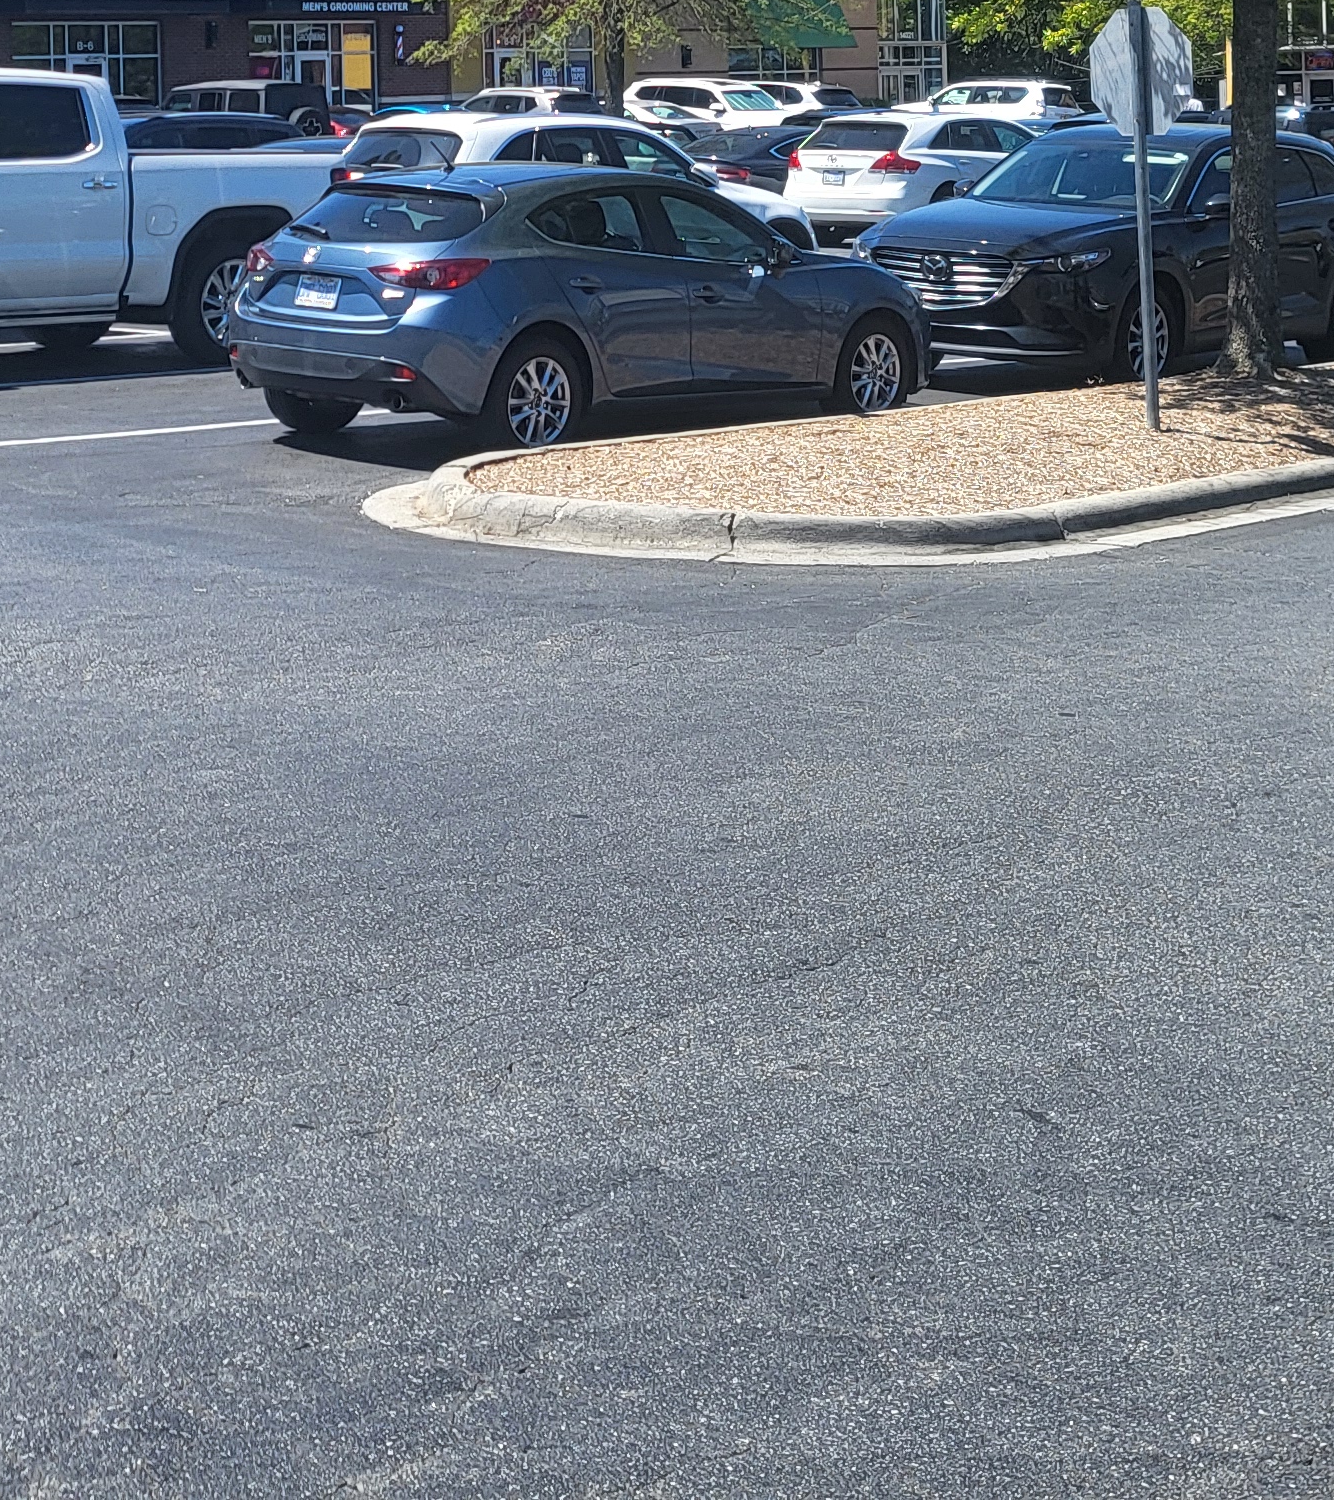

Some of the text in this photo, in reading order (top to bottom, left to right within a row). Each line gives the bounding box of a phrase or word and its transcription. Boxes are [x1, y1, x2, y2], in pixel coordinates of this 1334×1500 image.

[302, 2, 408, 11] MEN'S GROOMING CENTER
[77, 41, 94, 51] B-6
